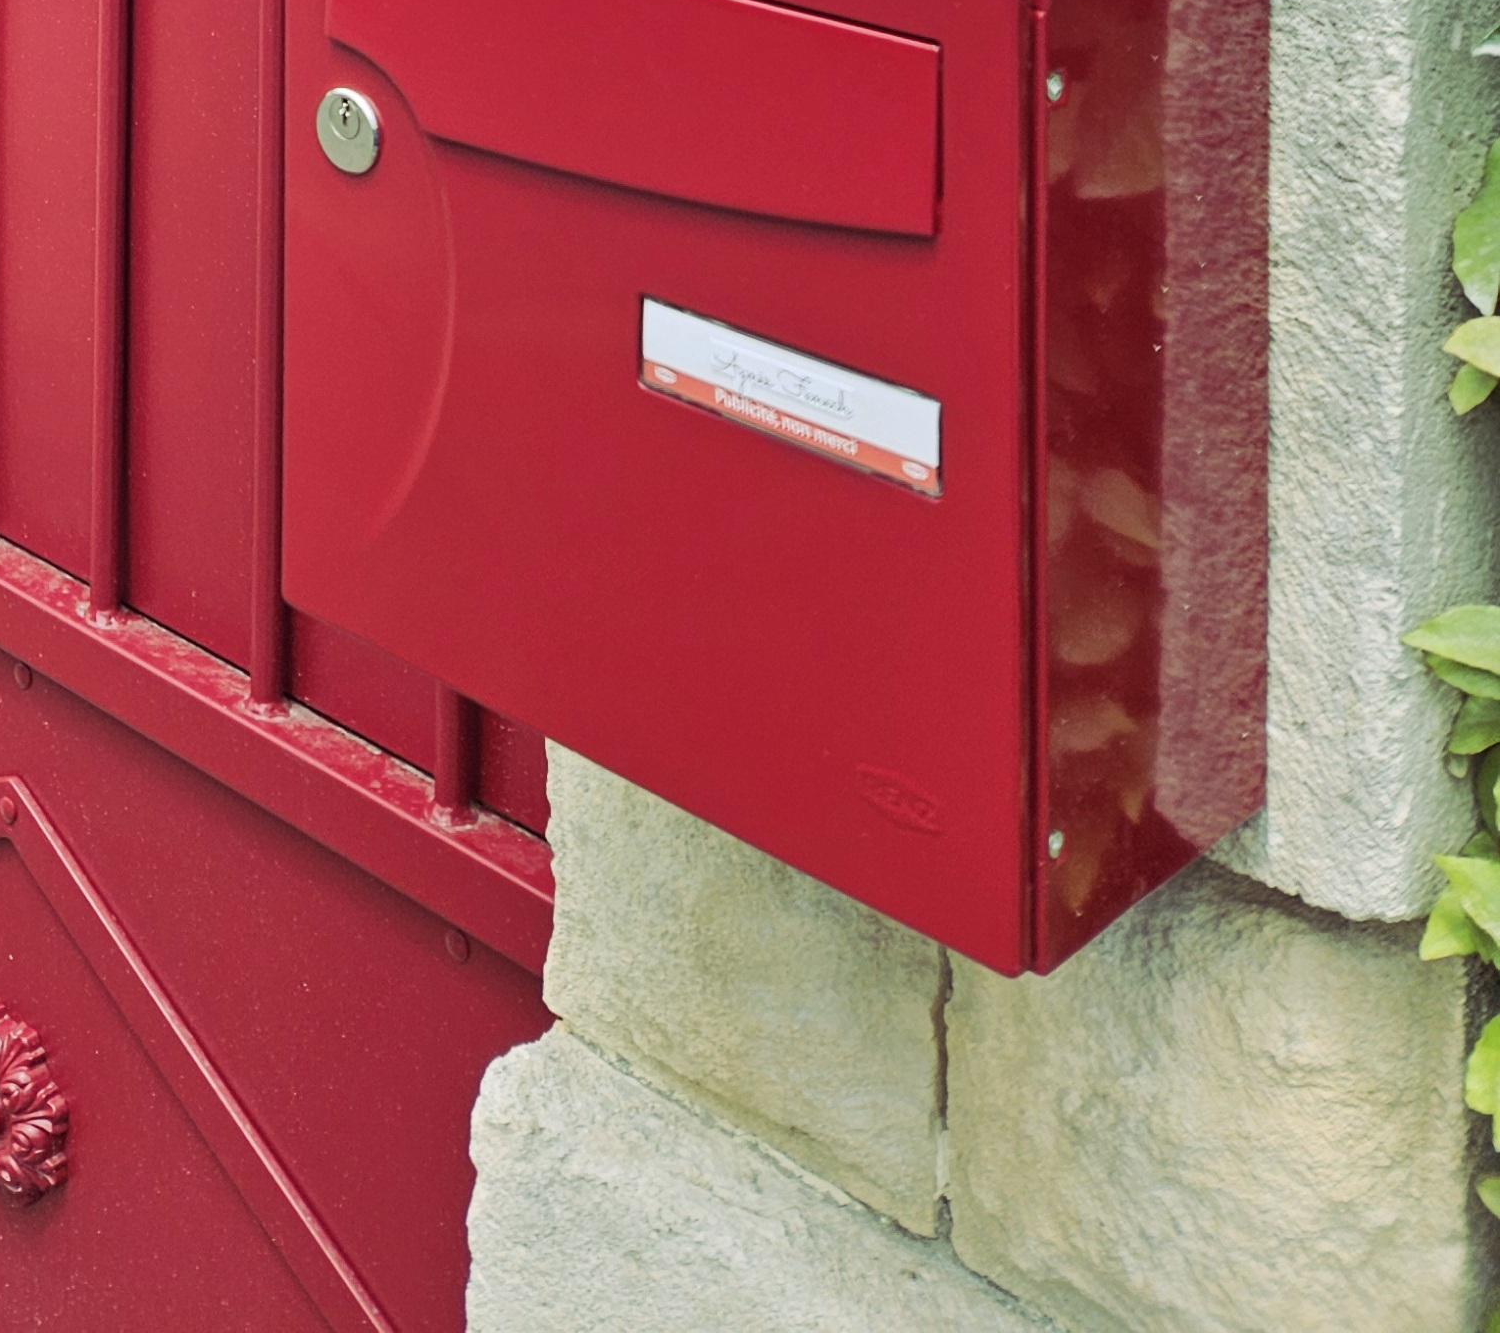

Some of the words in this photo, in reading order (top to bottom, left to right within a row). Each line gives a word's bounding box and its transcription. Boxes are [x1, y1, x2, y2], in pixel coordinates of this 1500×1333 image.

[714, 386, 782, 429] Publicité,
[782, 418, 812, 439] non
[813, 429, 859, 457] merci
